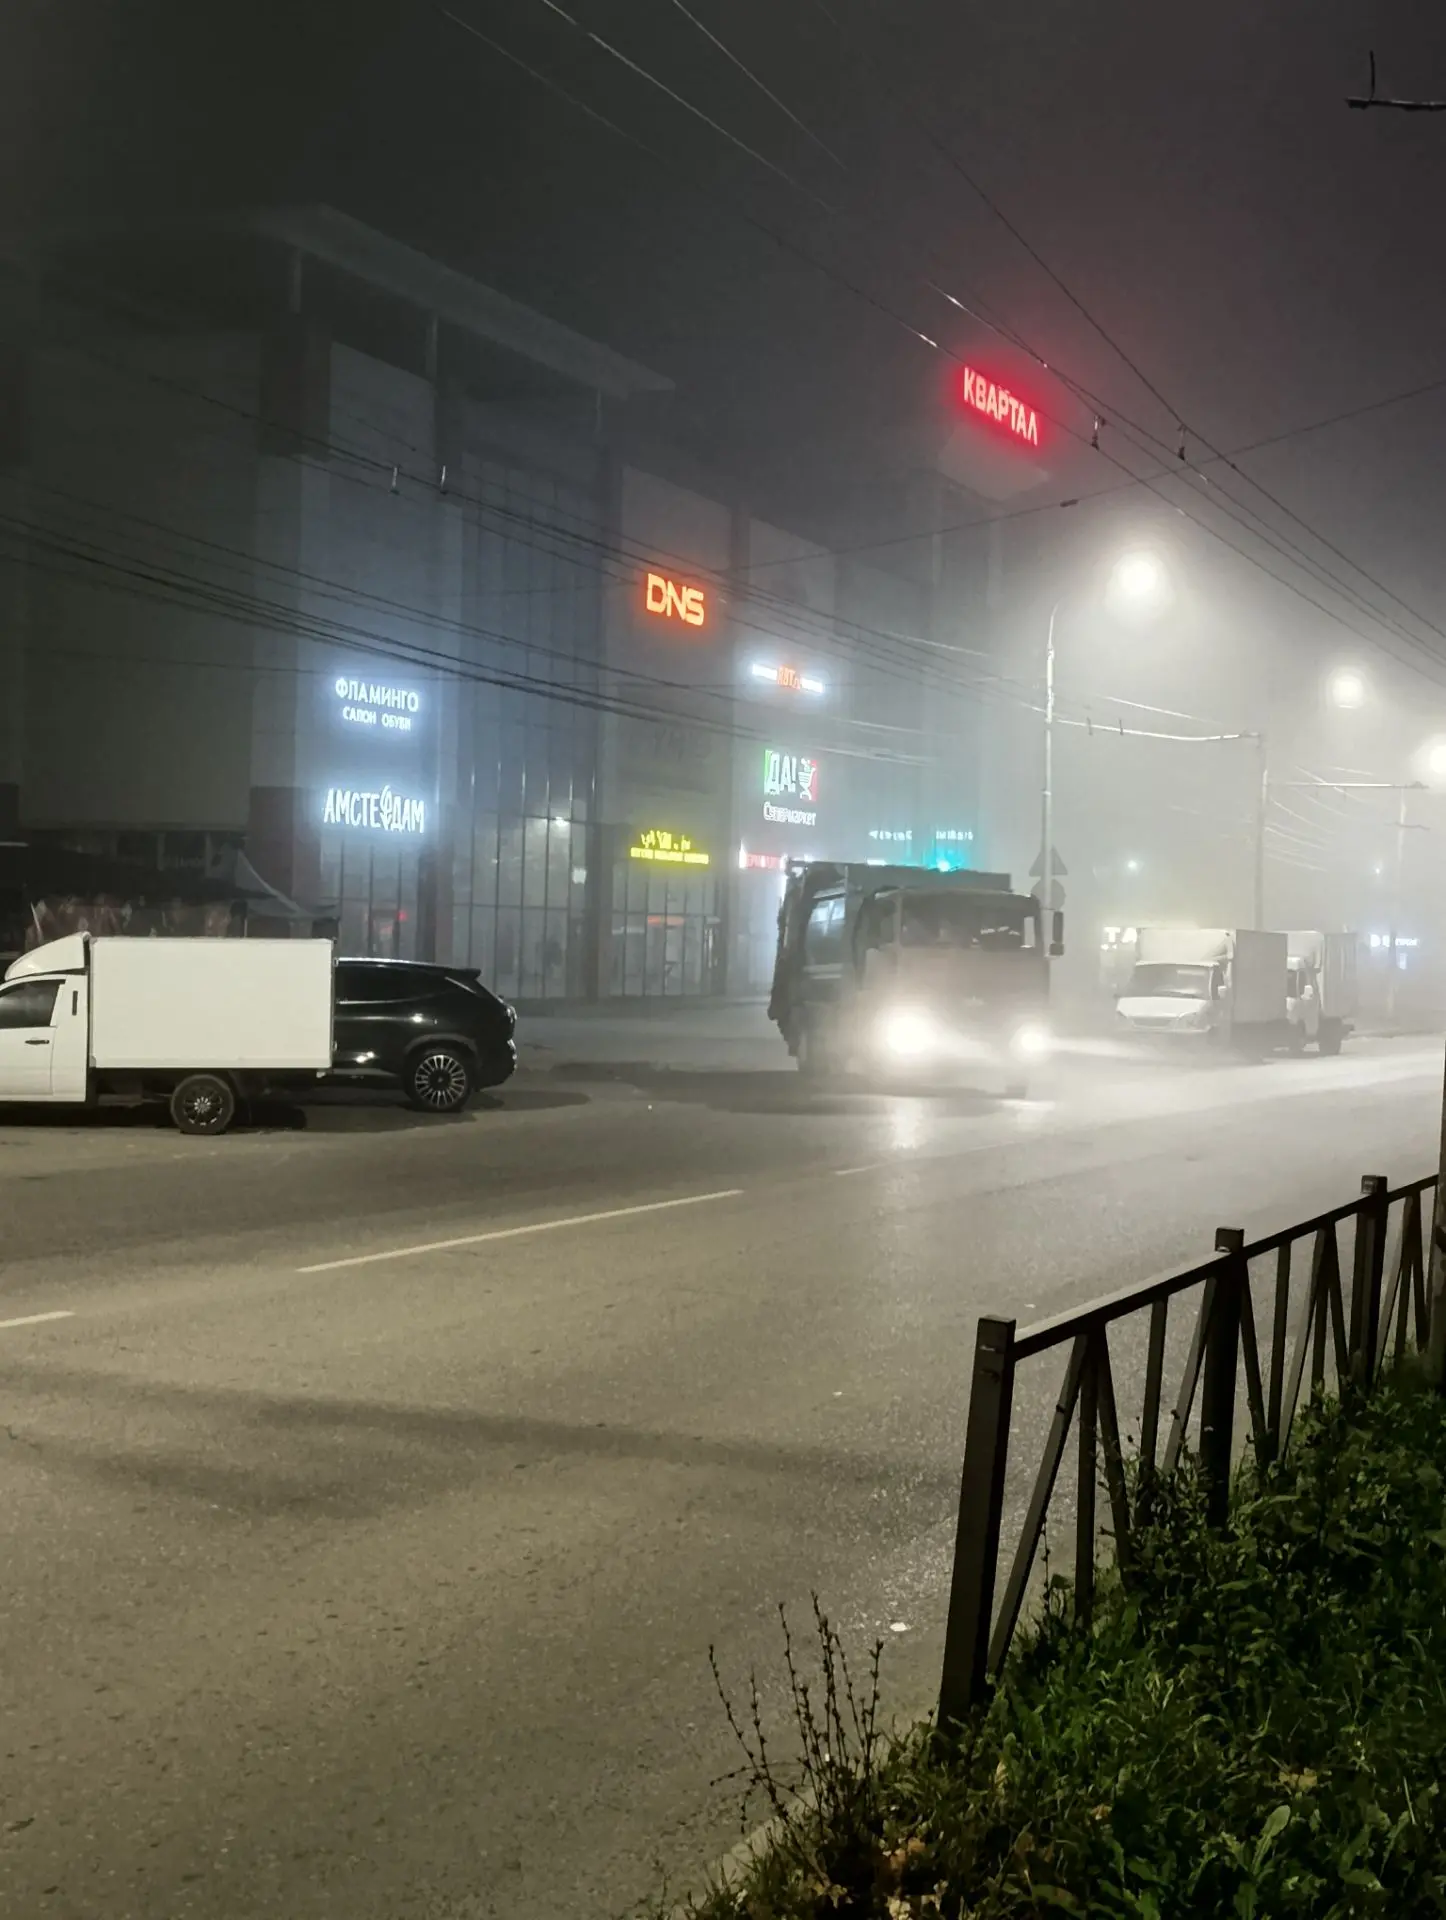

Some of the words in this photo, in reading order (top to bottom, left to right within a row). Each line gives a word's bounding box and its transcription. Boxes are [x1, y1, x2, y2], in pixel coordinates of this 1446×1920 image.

[964, 366, 1037, 446] КВАРТАЛ
[646, 572, 704, 626] DNS
[335, 677, 419, 712] ФЛАМИНГО
[342, 706, 377, 724] САЛОН
